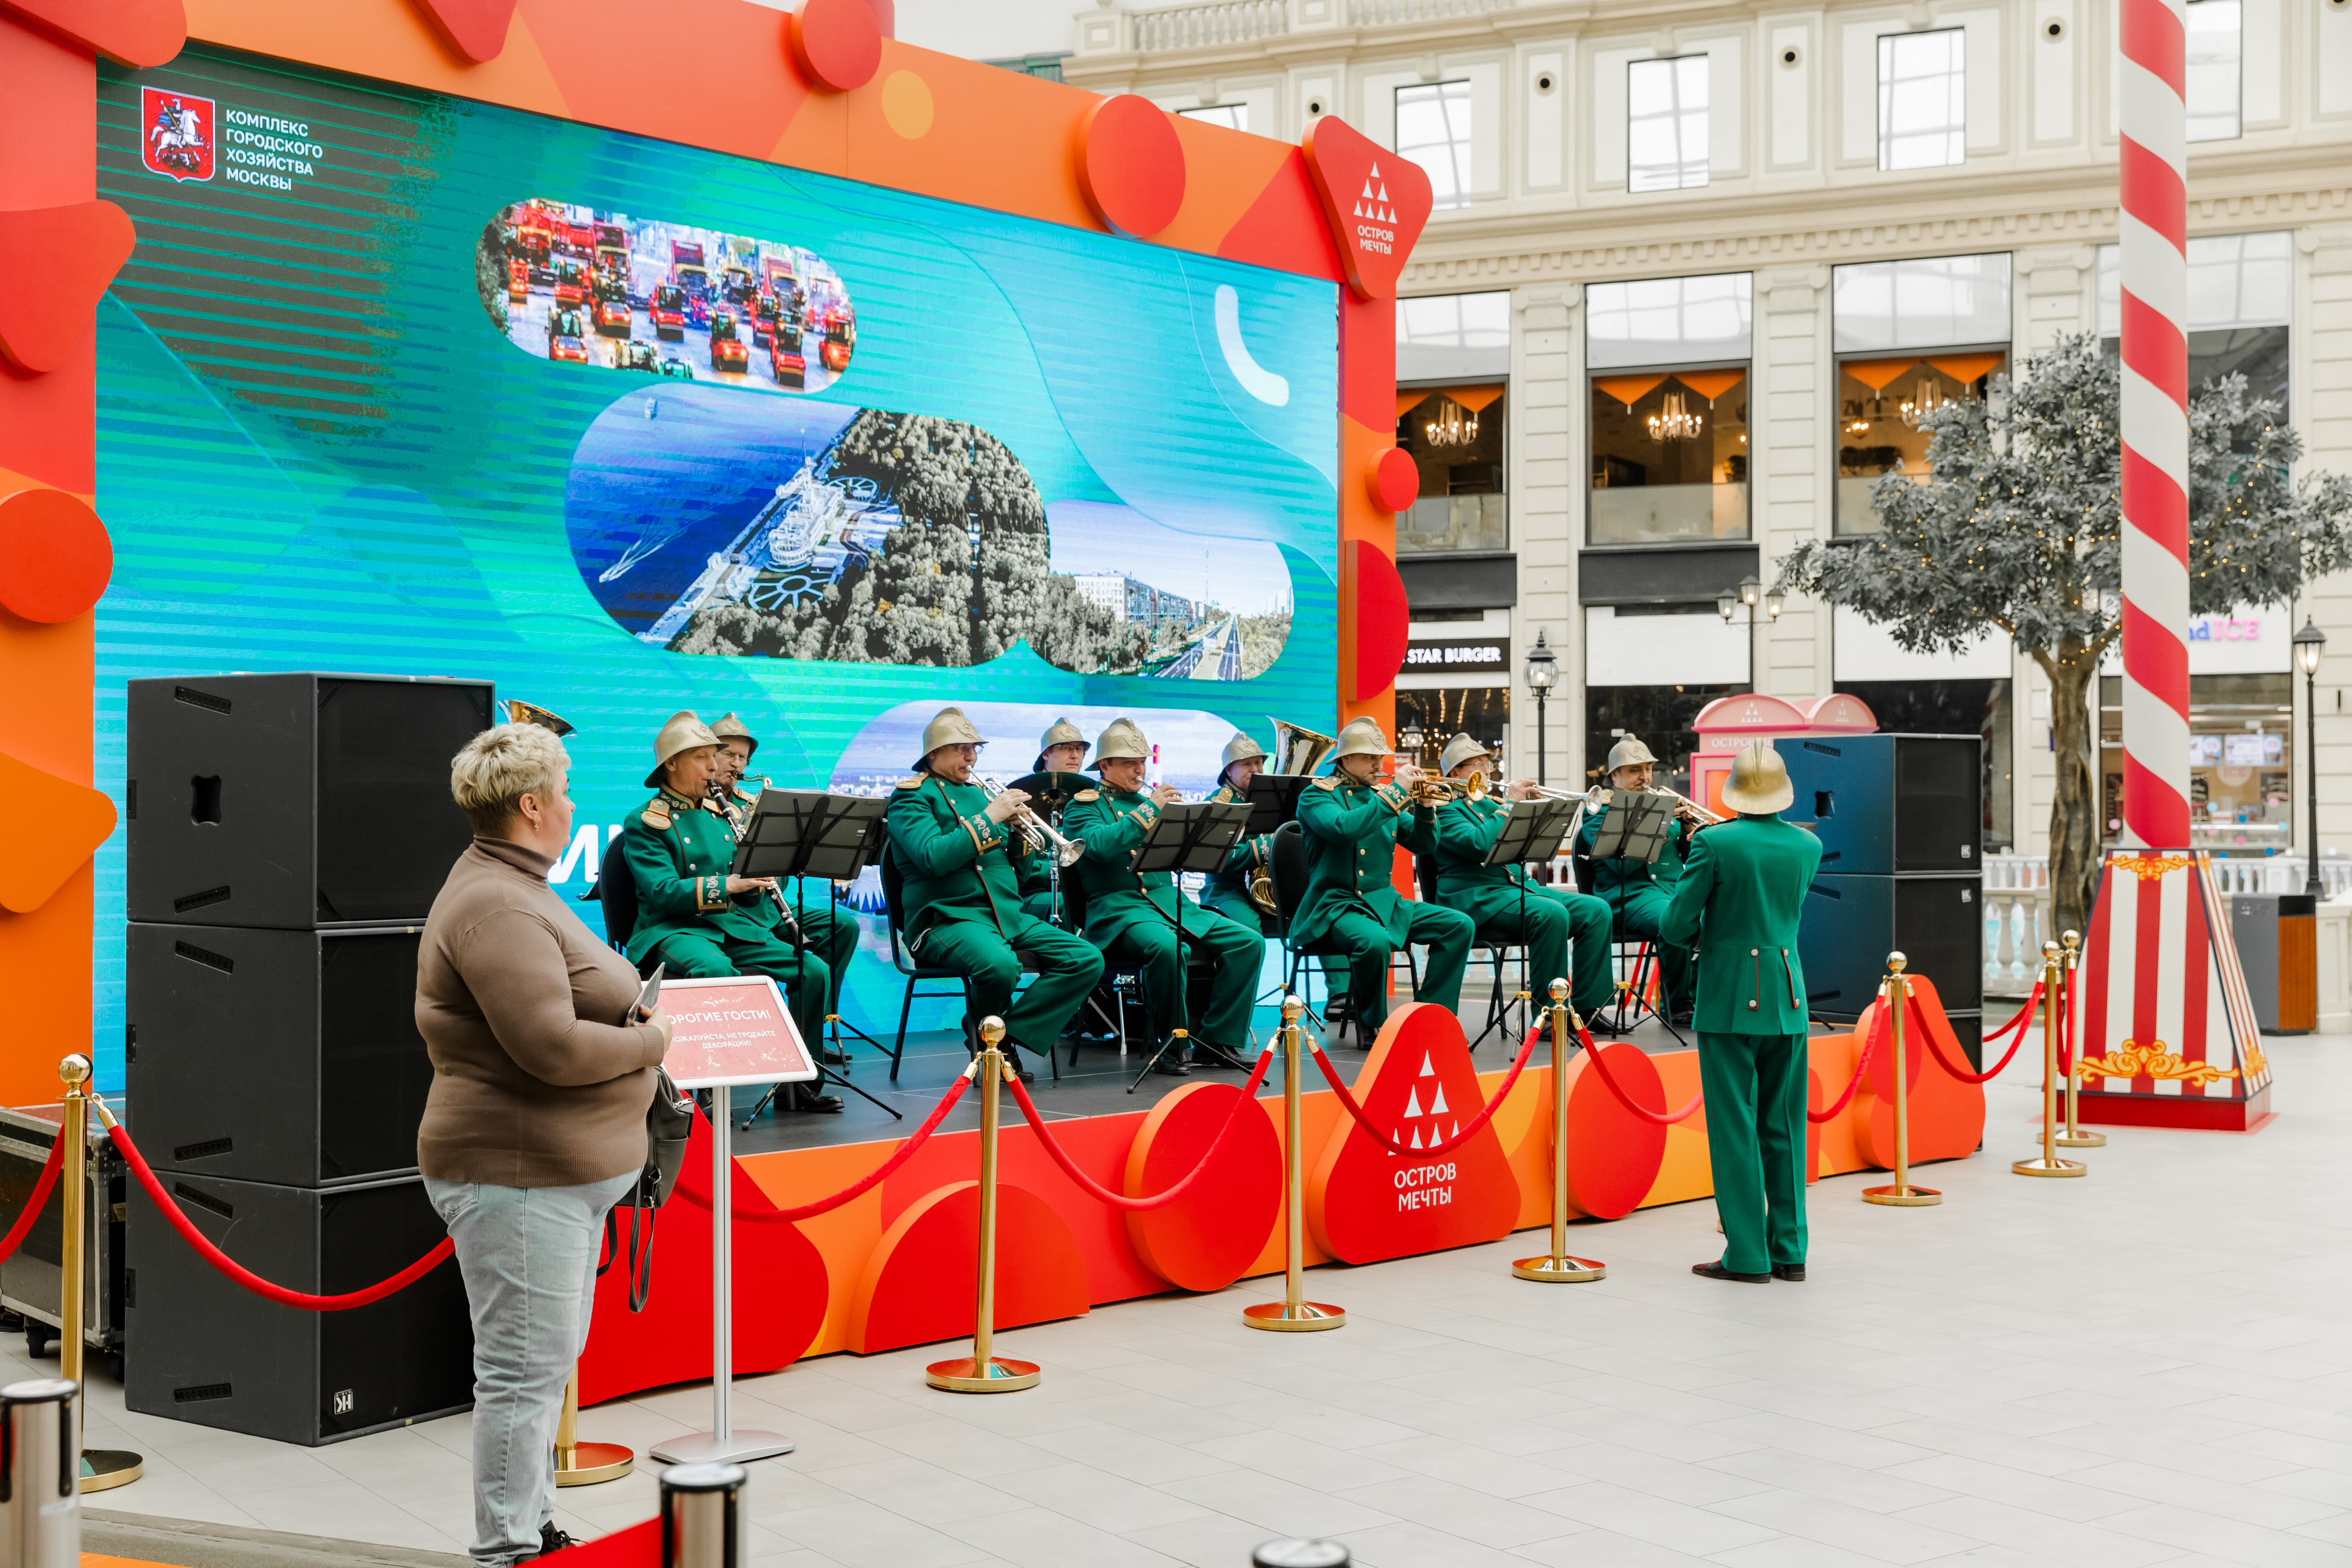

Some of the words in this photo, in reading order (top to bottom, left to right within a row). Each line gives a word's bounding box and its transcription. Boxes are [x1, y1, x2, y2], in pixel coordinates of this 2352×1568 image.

[226, 109, 309, 137] КОМПЛЕКС
[226, 129, 323, 159] ГОРОДСКОГО
[226, 147, 314, 176] ХОЗЯЙСТВА
[226, 167, 292, 191] МОСКВЫ
[1357, 225, 1394, 242] ОСТРОВ
[1360, 239, 1391, 255] МЕЧТЫ
[2213, 620, 2260, 640] ICE
[1407, 648, 1442, 664] STAR
[1445, 647, 1501, 663] BURGER
[1711, 737, 1755, 747] ОСТРОВ
[666, 1011, 723, 1024] ОРОГИЕ
[723, 1010, 771, 1021] ГОСТИ!
[738, 1030, 776, 1038] ТРОГАЙТЕ
[702, 1040, 752, 1049] ДЕКОРАЦИИ!
[1394, 1162, 1456, 1188] ОСТРОВ
[1399, 1186, 1452, 1212] МЕЧТЫ
[336, 1394, 351, 1413] HK
